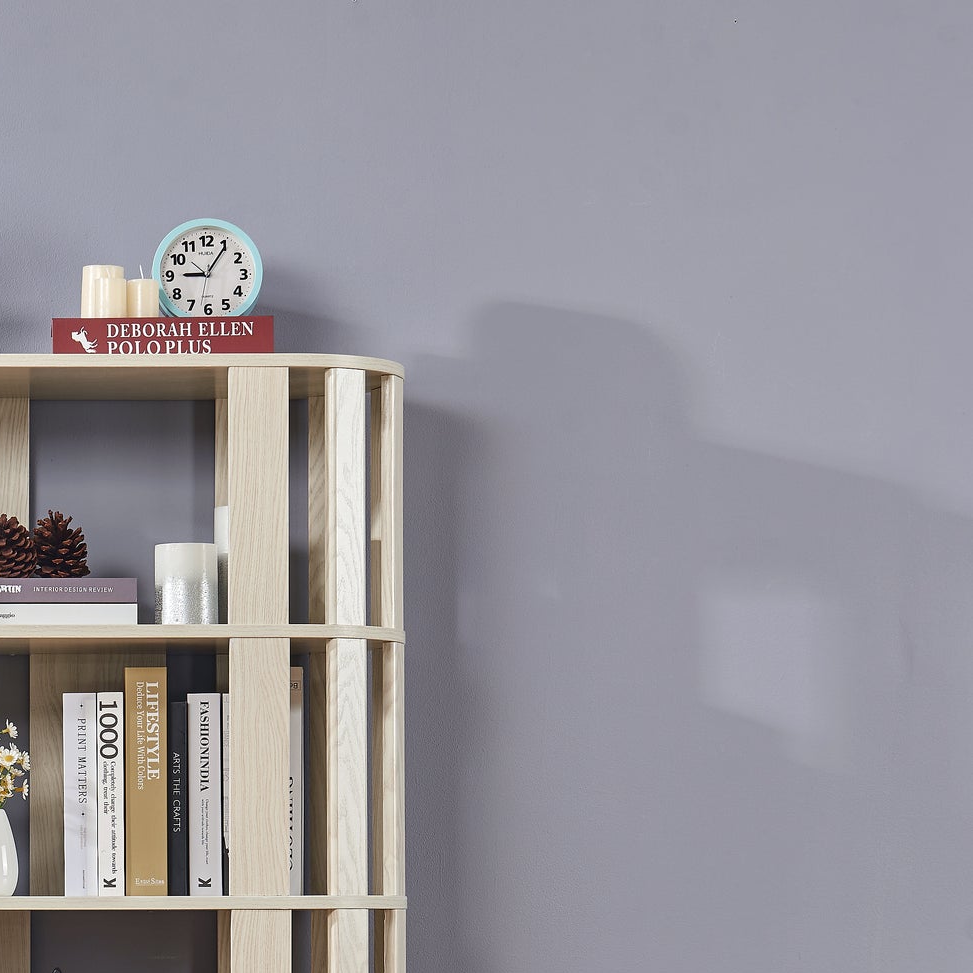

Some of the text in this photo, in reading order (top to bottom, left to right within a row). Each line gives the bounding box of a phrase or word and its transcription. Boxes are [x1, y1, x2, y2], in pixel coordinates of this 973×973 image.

[181, 241, 195, 252] 11
[199, 236, 214, 247] 12
[220, 240, 227, 251] 1
[171, 254, 186, 265] 10
[233, 252, 242, 264] 2
[165, 270, 174, 282] 9
[239, 269, 248, 280] 3
[172, 288, 181, 300] 8
[233, 286, 243, 297] 4
[187, 300, 195, 311] 7
[204, 304, 213, 315] 6
[221, 299, 231, 310] 5
[106, 322, 254, 338] DEBORAH ELLEN
[107, 340, 211, 354] POLO PLUS
[137, 711, 145, 728] Your
[99, 701, 118, 759] 1000
[146, 682, 160, 780] LIFESTYLE
[137, 731, 145, 744] Life
[200, 702, 209, 792] FASHIONINDIA
[78, 718, 87, 803] PRINT MATTERS
[137, 746, 145, 764] With
[138, 766, 146, 790] Colors
[173, 800, 181, 832] CRAFTS
[104, 878, 116, 888] K
[198, 878, 211, 887] K
